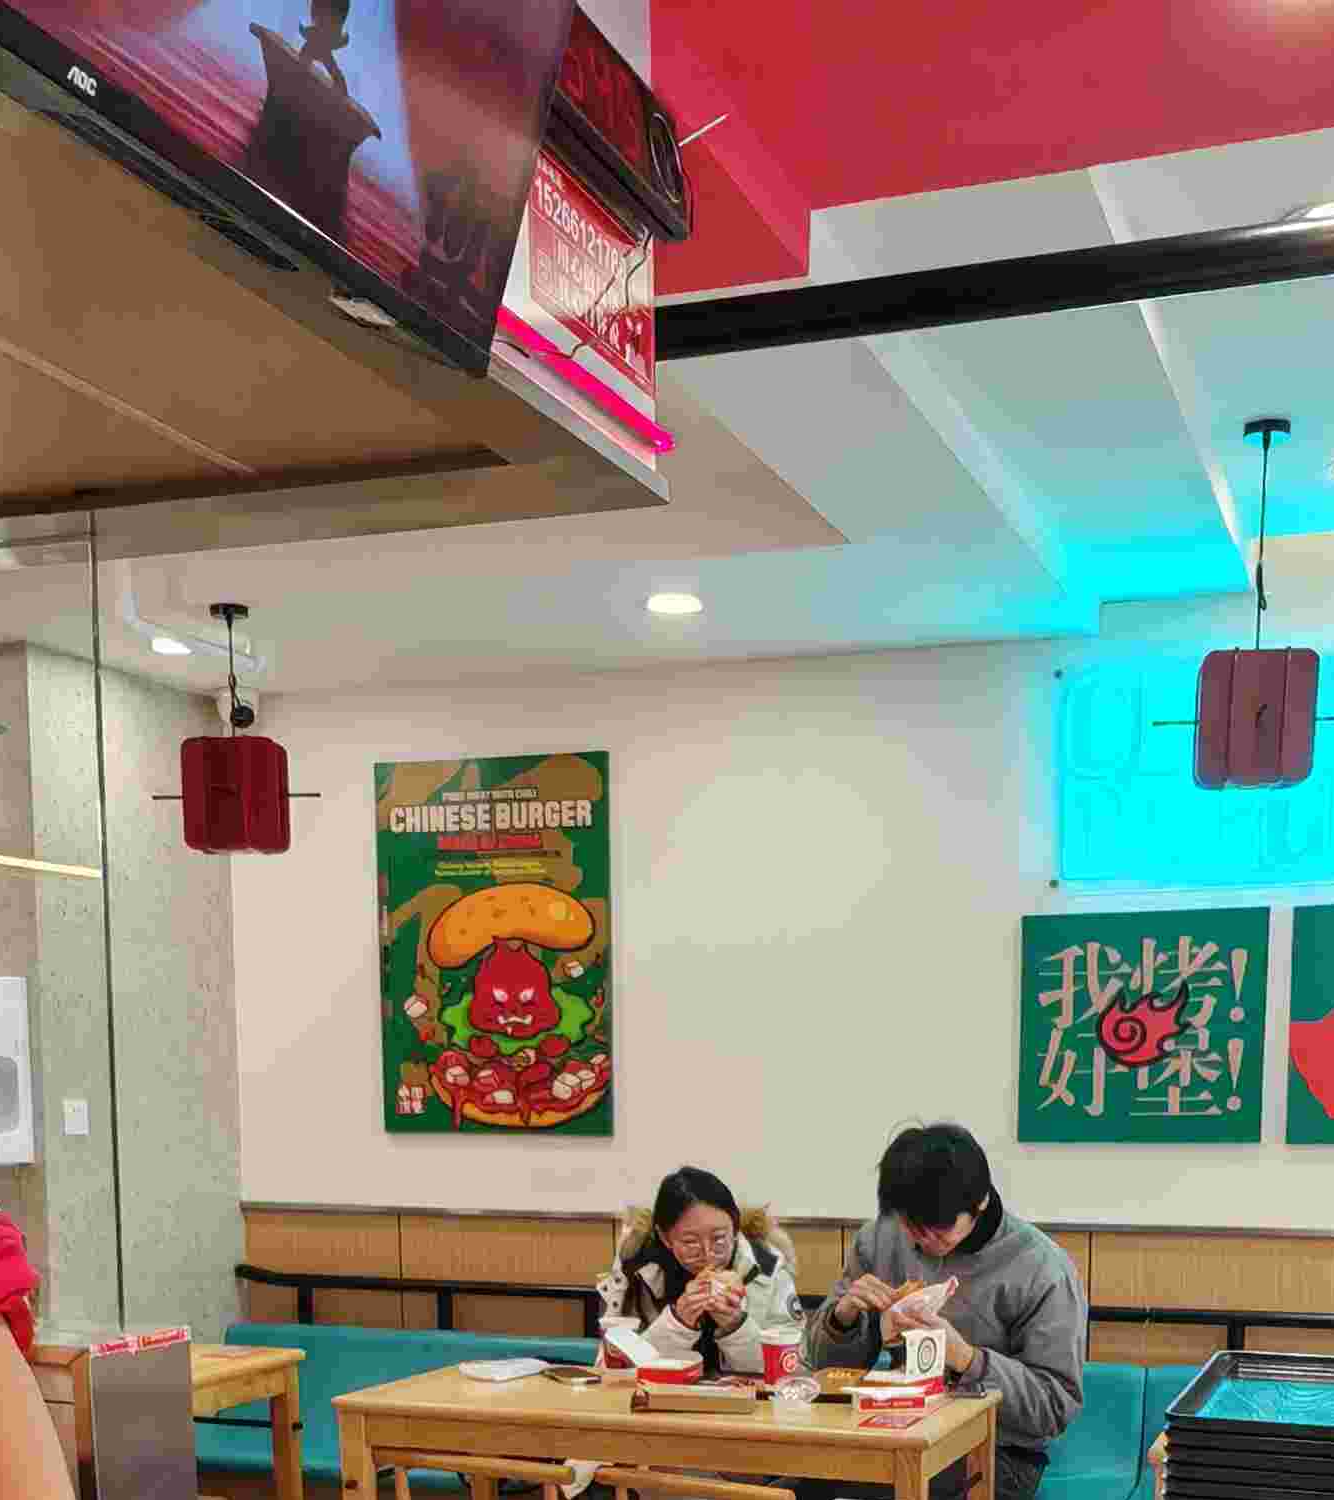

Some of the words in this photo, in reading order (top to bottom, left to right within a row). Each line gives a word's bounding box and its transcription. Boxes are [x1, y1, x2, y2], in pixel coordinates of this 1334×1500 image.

[67, 65, 98, 97] AOC
[389, 802, 492, 833] CHINESE
[495, 799, 592, 830] BURGER
